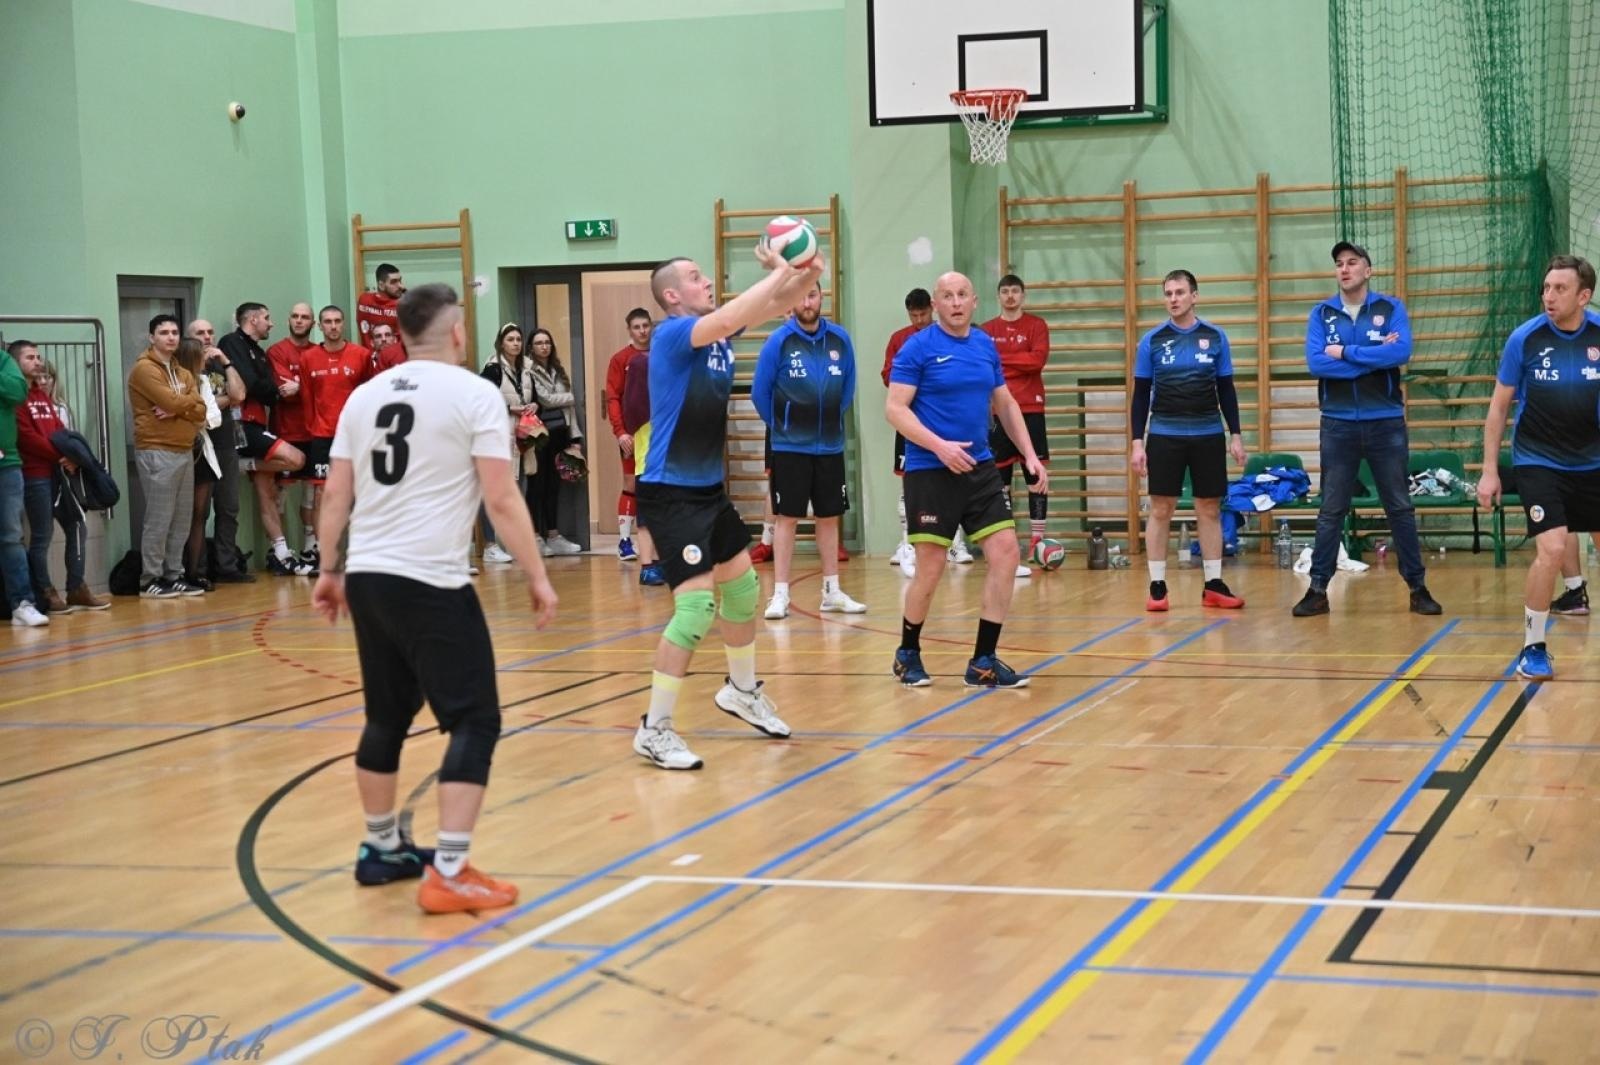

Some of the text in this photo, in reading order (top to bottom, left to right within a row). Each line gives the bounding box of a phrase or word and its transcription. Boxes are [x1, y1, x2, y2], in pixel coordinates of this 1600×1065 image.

[1329, 324, 1336, 334] 3
[1164, 346, 1171, 355] 5
[791, 359, 803, 368] 91
[1542, 357, 1551, 368] 6
[789, 368, 807, 378] M.S
[1534, 369, 1559, 381] M.S
[371, 402, 415, 486] 3
